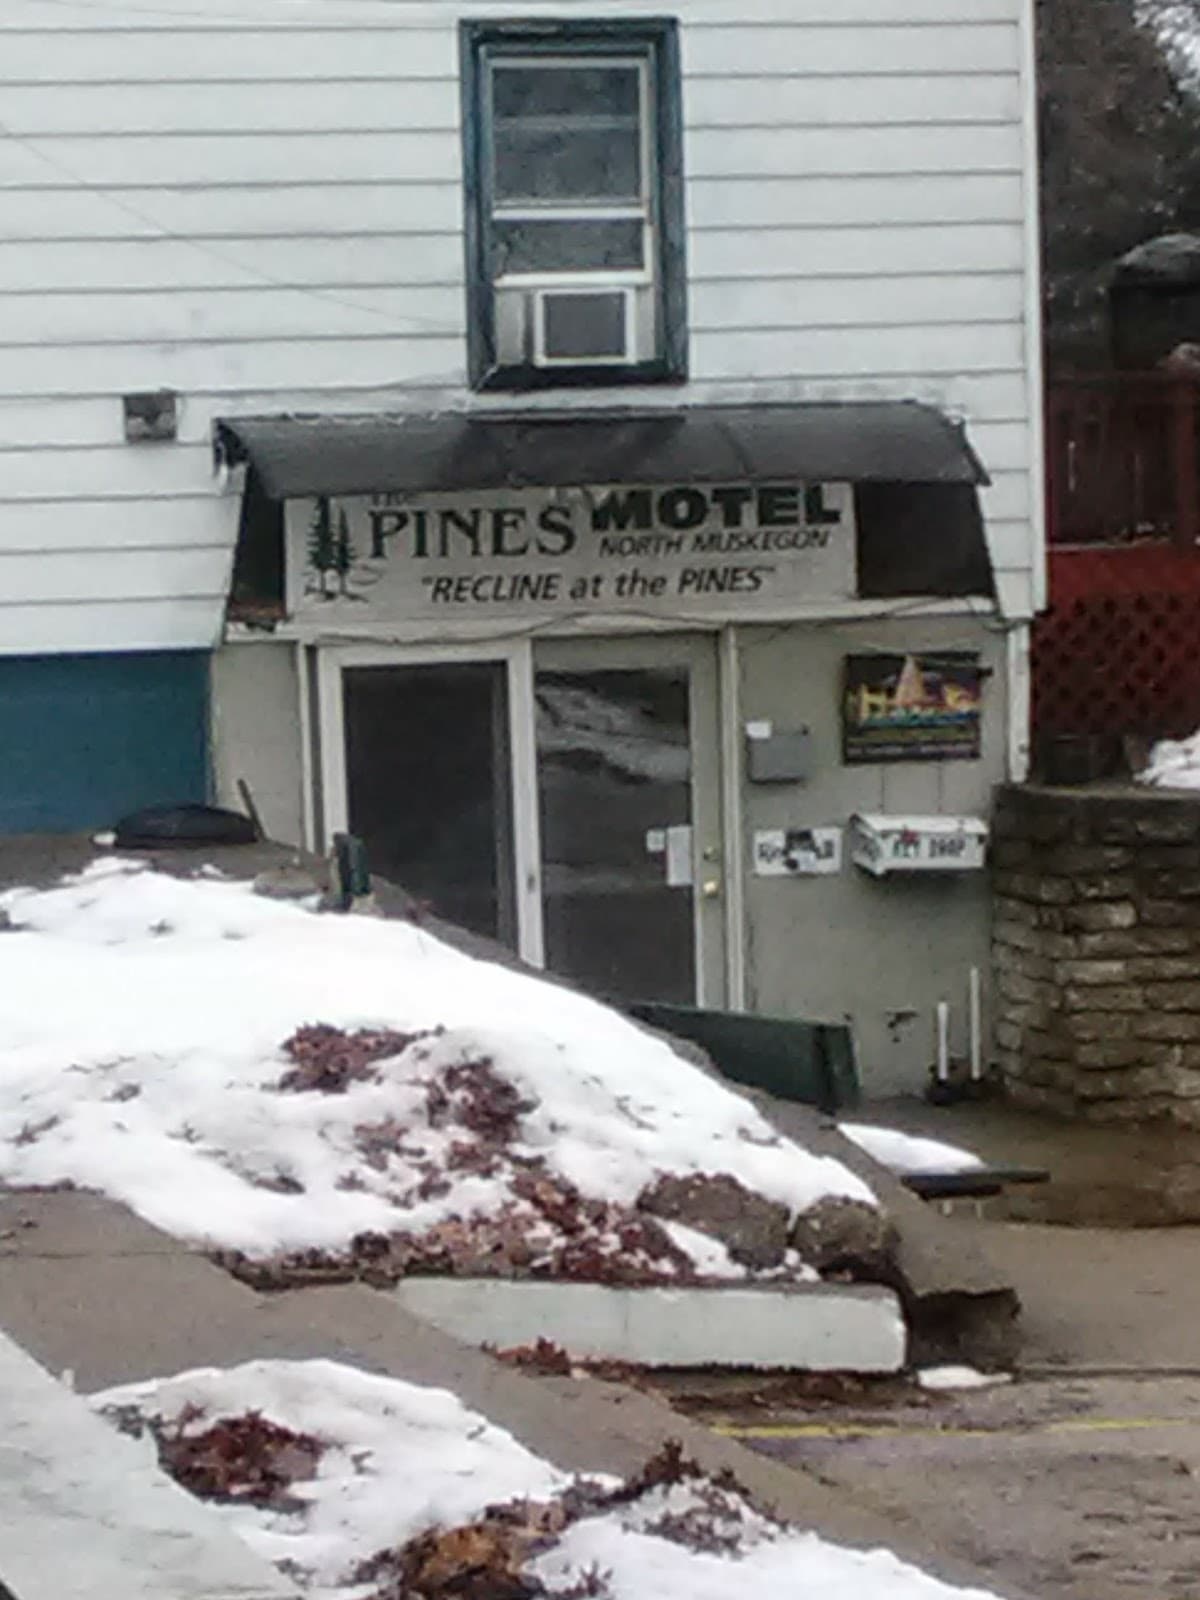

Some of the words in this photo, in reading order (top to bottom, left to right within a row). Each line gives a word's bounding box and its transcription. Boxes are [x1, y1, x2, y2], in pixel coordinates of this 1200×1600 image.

[369, 507, 577, 557] PINES
[591, 485, 841, 530] MOTEL
[600, 535, 684, 557] NORTH
[691, 530, 830, 553] MUSKEGON
[422, 572, 561, 602] "RECLINE
[569, 574, 605, 600] at
[615, 568, 668, 597] the
[677, 566, 775, 594] PINES"
